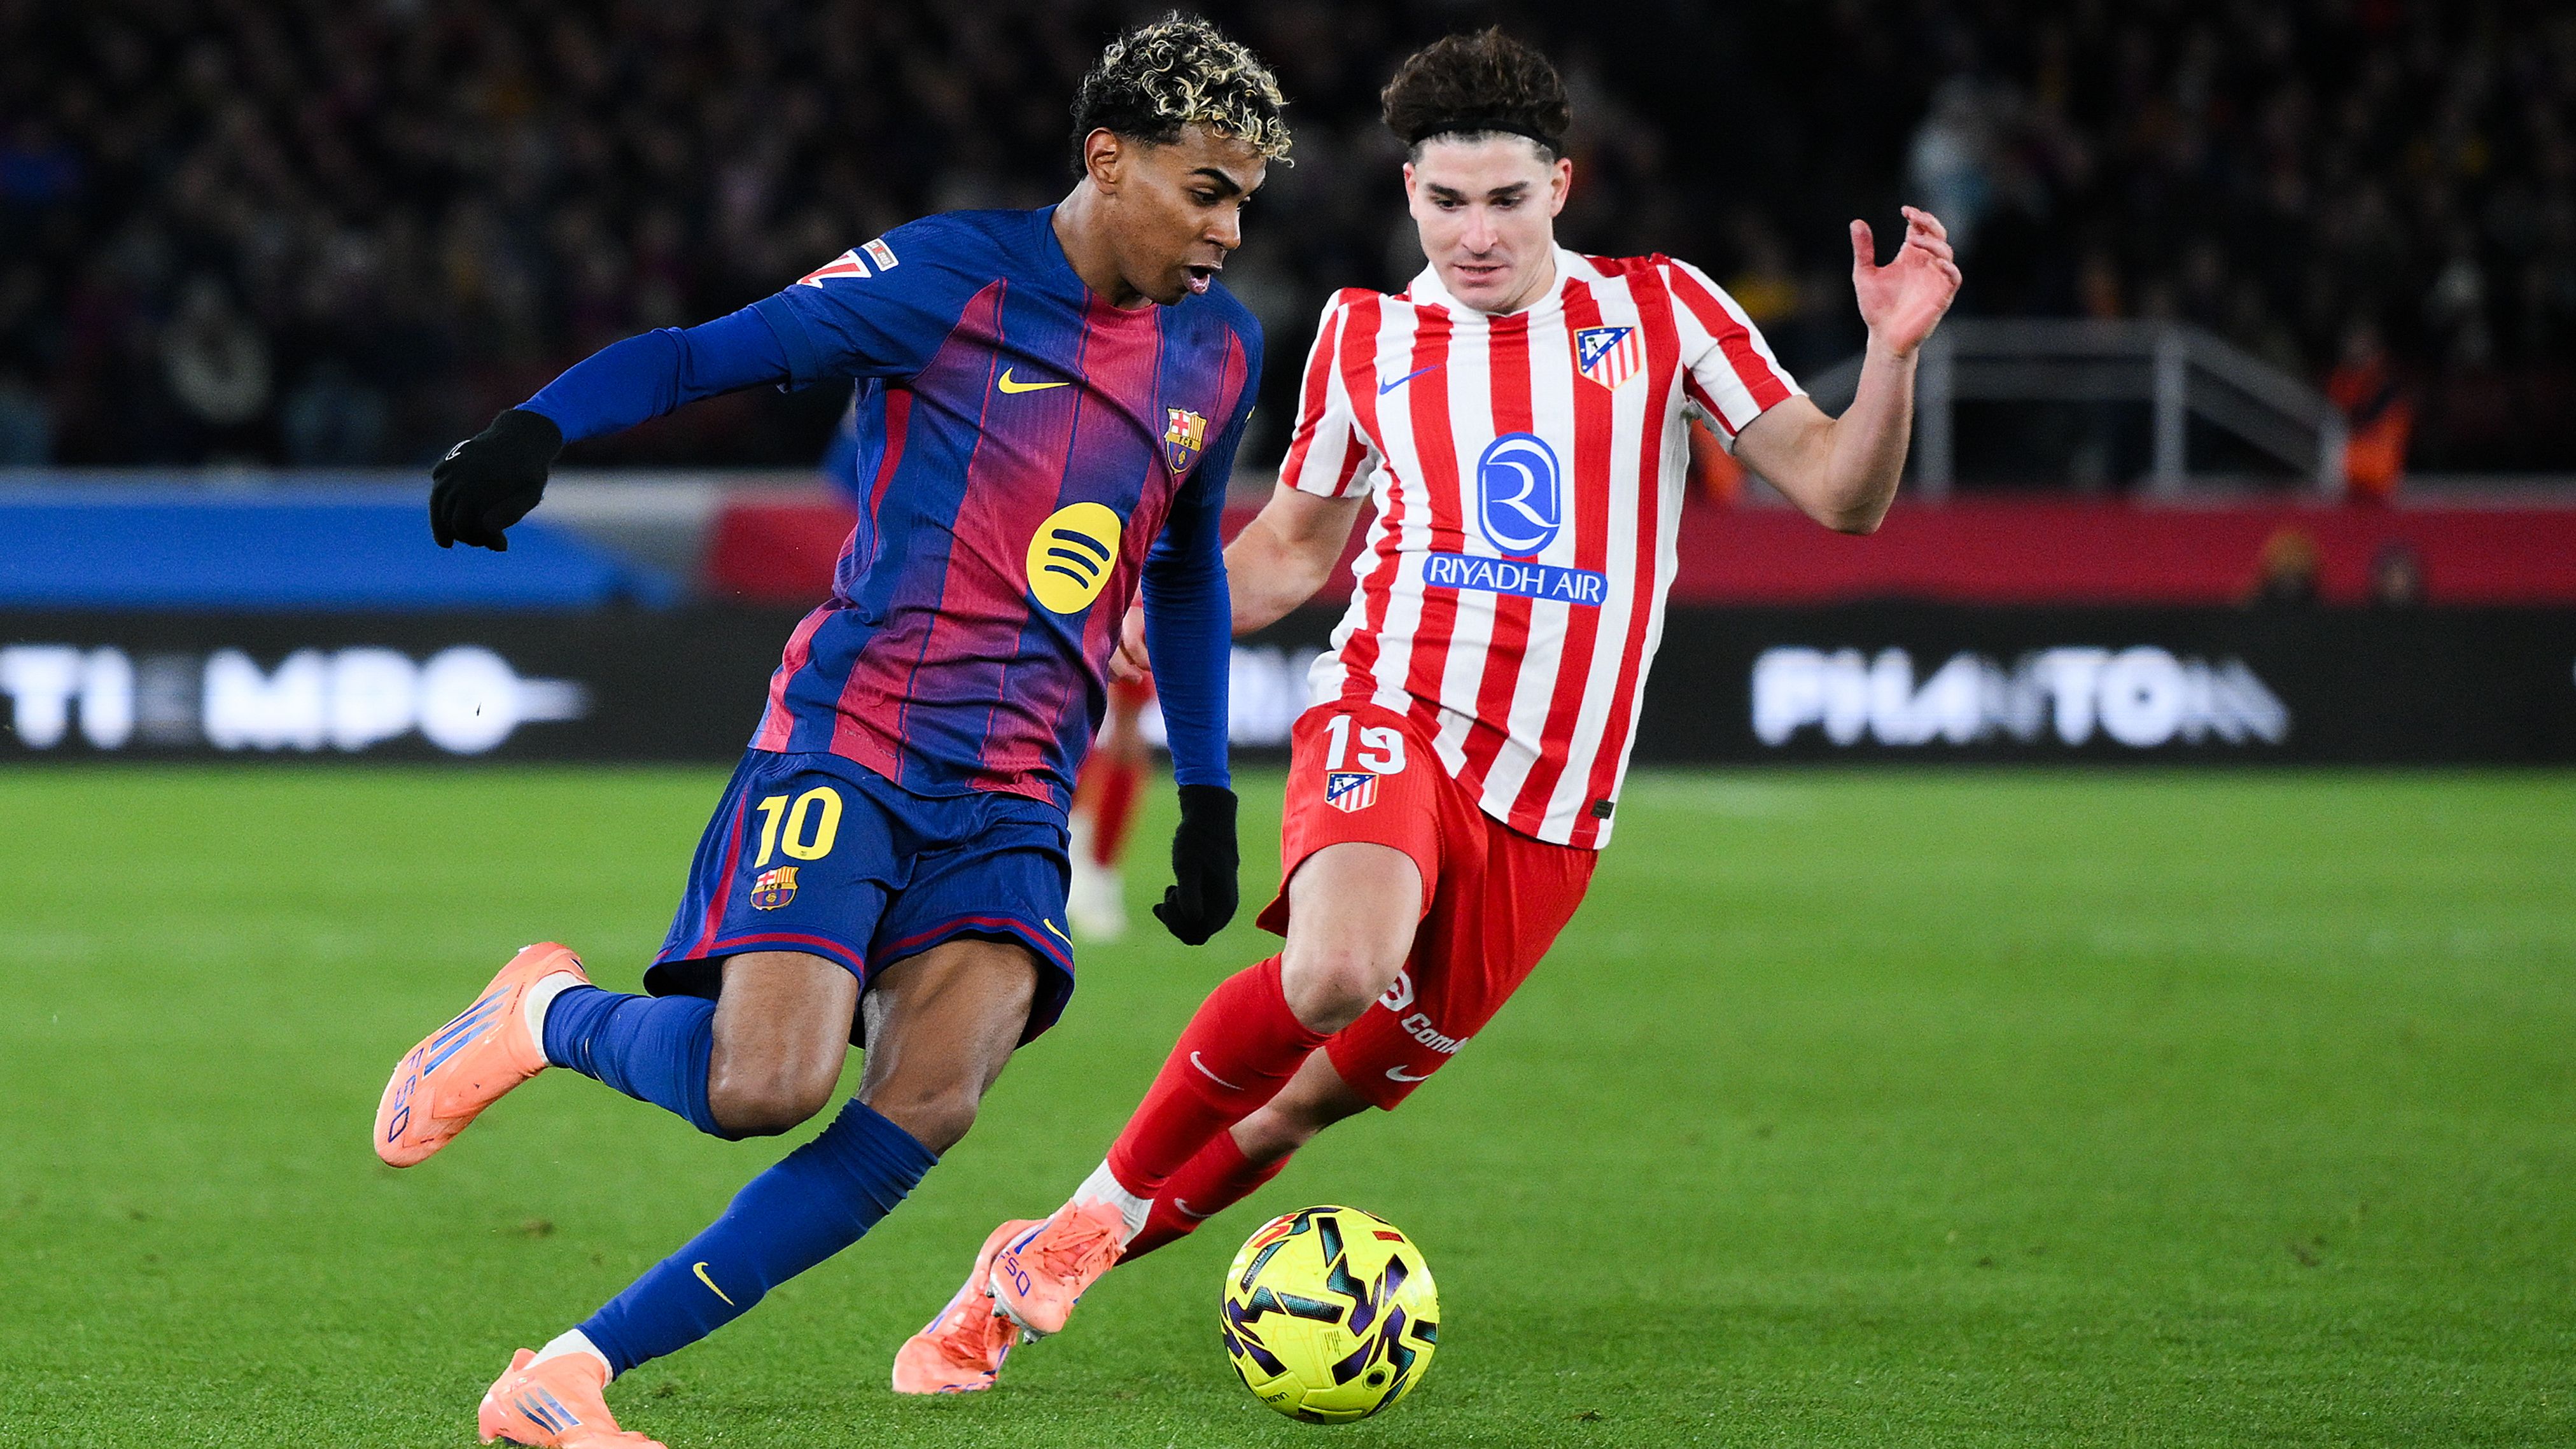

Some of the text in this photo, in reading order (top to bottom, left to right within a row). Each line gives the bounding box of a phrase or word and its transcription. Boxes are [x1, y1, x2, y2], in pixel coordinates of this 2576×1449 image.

[1179, 436, 1193, 448] FCB
[1429, 556, 1602, 603] RIYADH AIR
[1324, 714, 1407, 775] 19
[754, 786, 843, 868] 10
